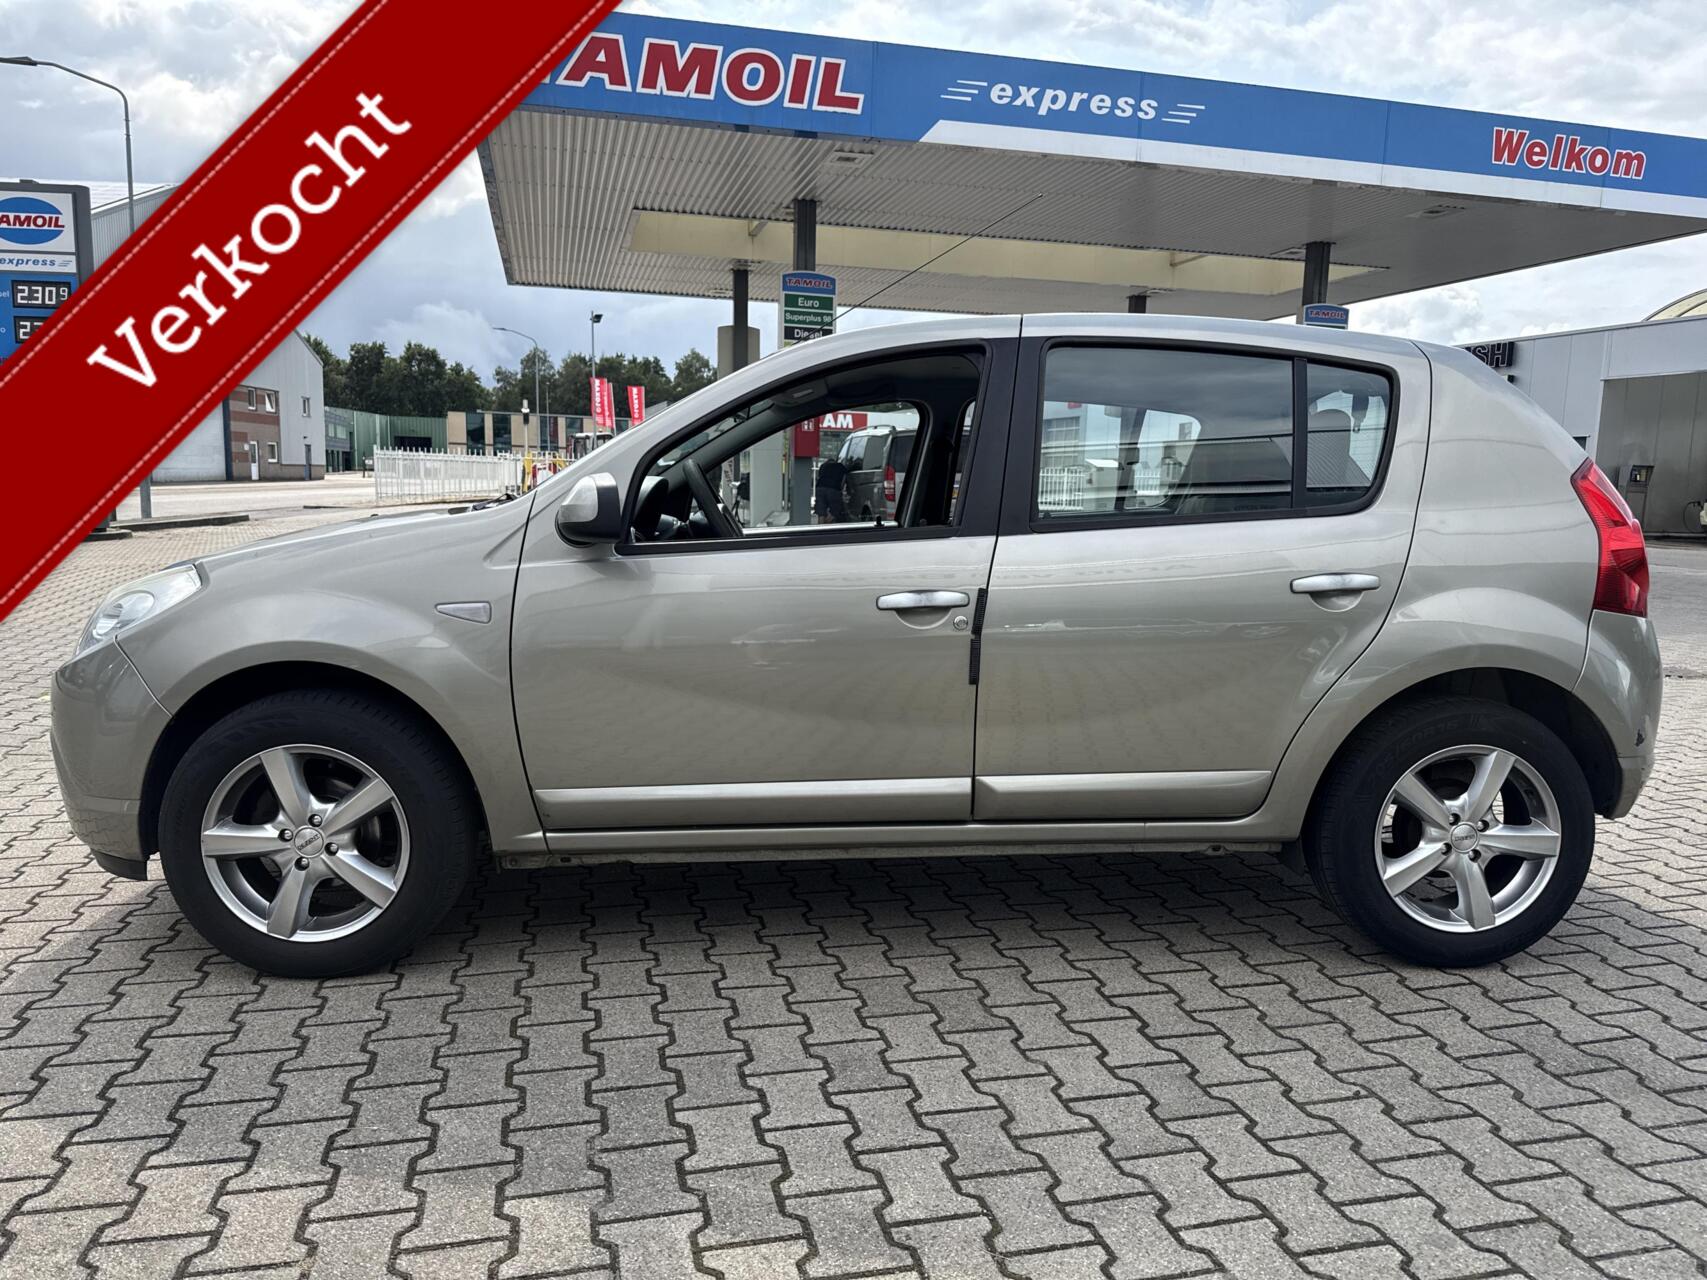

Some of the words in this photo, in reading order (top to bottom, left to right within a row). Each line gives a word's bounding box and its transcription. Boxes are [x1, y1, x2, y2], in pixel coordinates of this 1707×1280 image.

[541, 31, 865, 115] AMOIL
[989, 82, 1158, 120] express
[1491, 126, 1647, 180] Welkom
[0, 214, 65, 229] AMOIL
[786, 278, 833, 289] TAMOIL
[798, 297, 820, 308] Euro
[785, 312, 822, 323] Superplus
[1309, 310, 1346, 319] TAMOIL
[1471, 342, 1508, 367] SH
[819, 413, 854, 428] AM
